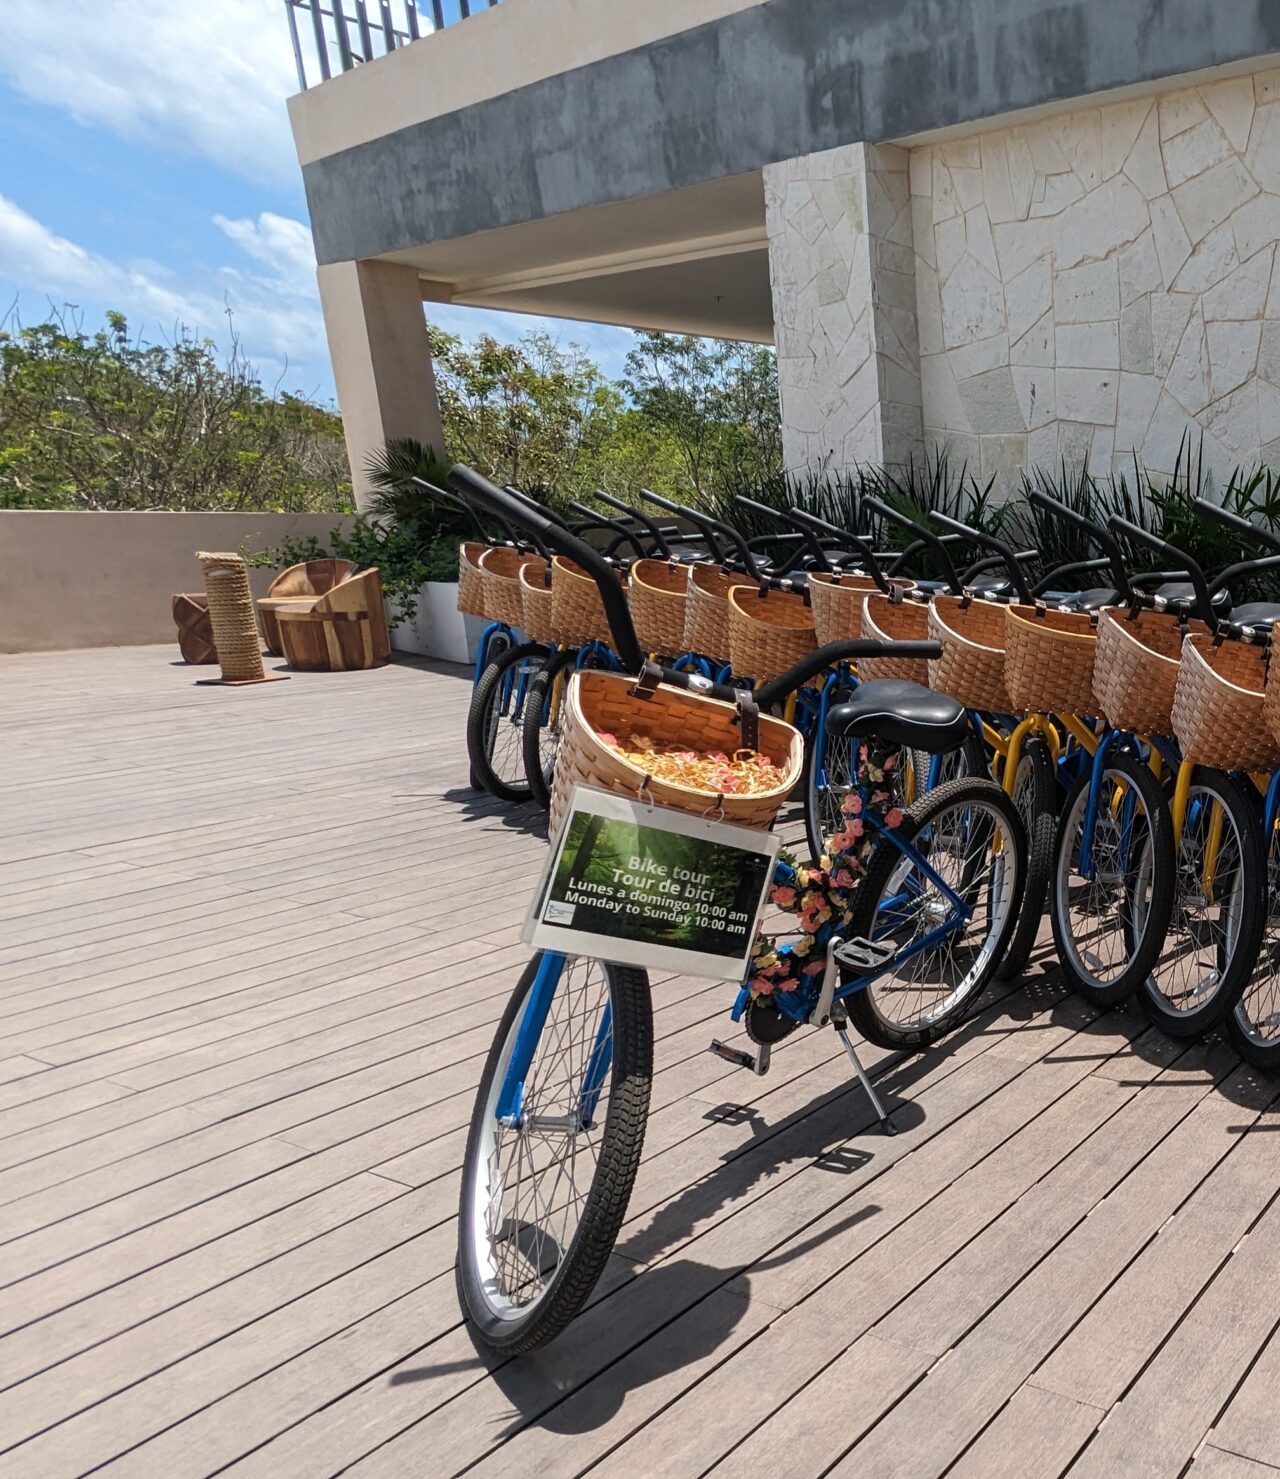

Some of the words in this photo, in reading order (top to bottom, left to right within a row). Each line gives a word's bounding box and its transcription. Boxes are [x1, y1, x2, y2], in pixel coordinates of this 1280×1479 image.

[613, 869, 654, 887] Tour
[659, 879, 679, 893] de
[685, 883, 715, 901] bici
[629, 856, 667, 875] Bike
[674, 867, 710, 883] tour
[565, 891, 621, 912] Monday
[626, 903, 640, 915] to
[643, 906, 691, 925] Sunday
[695, 917, 725, 930] 10:00
[727, 923, 746, 935] am
[568, 877, 613, 895] Lunes
[618, 888, 625, 898] a
[630, 889, 690, 912] domingo
[694, 903, 726, 916] 10:00
[729, 910, 748, 922] am
